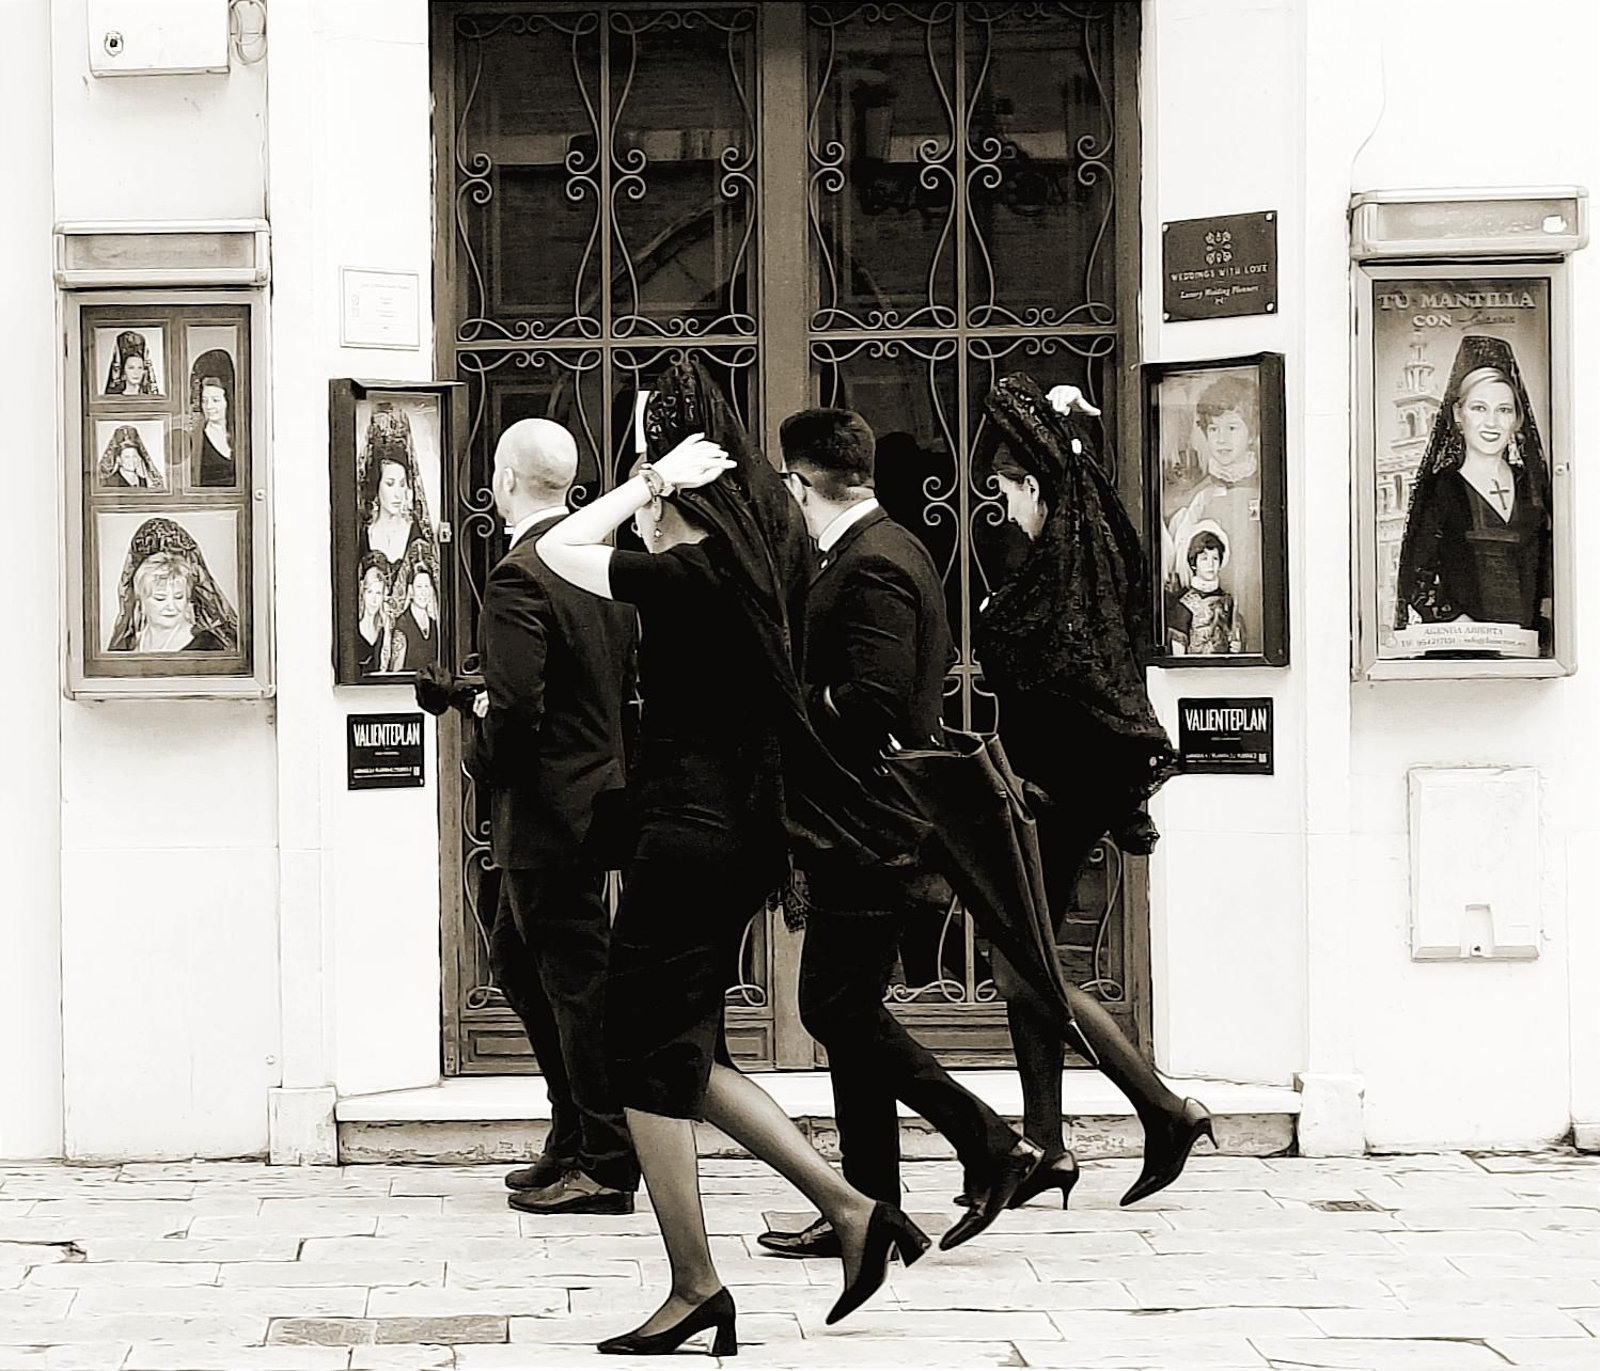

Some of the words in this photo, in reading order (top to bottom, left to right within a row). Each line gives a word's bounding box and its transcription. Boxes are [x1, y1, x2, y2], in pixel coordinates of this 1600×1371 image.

[1170, 269, 1215, 281] WEDDINGS
[1219, 266, 1241, 277] WITH
[1244, 264, 1268, 274] LOVE
[1378, 293, 1410, 309] TU
[1420, 291, 1535, 309] MANTILLA
[1412, 314, 1452, 327] CON
[1184, 708, 1267, 732] VALIENTEPLAN
[353, 722, 420, 748] VALIENTEPLAN
